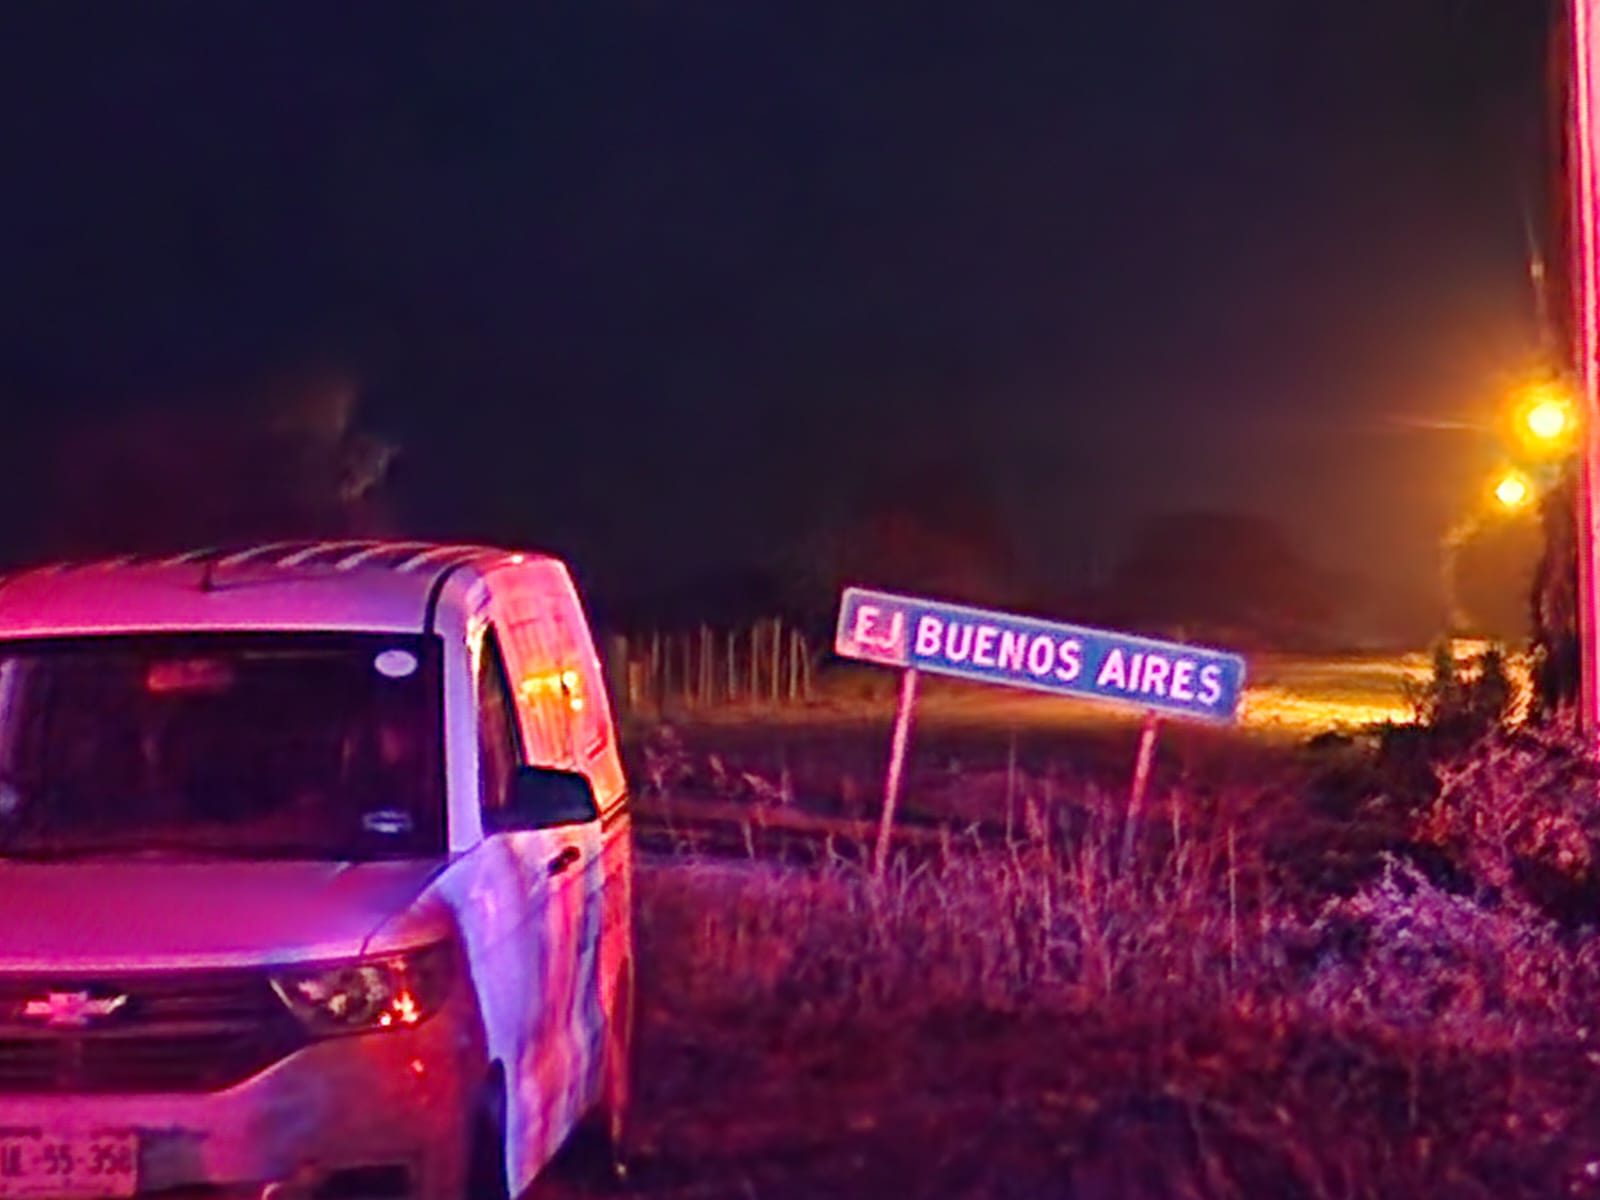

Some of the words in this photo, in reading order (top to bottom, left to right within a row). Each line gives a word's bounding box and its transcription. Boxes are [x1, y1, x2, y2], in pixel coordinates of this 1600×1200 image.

[854, 605, 904, 649] EJ
[915, 615, 1081, 681] BUENOS
[1097, 648, 1222, 706] AIRES
